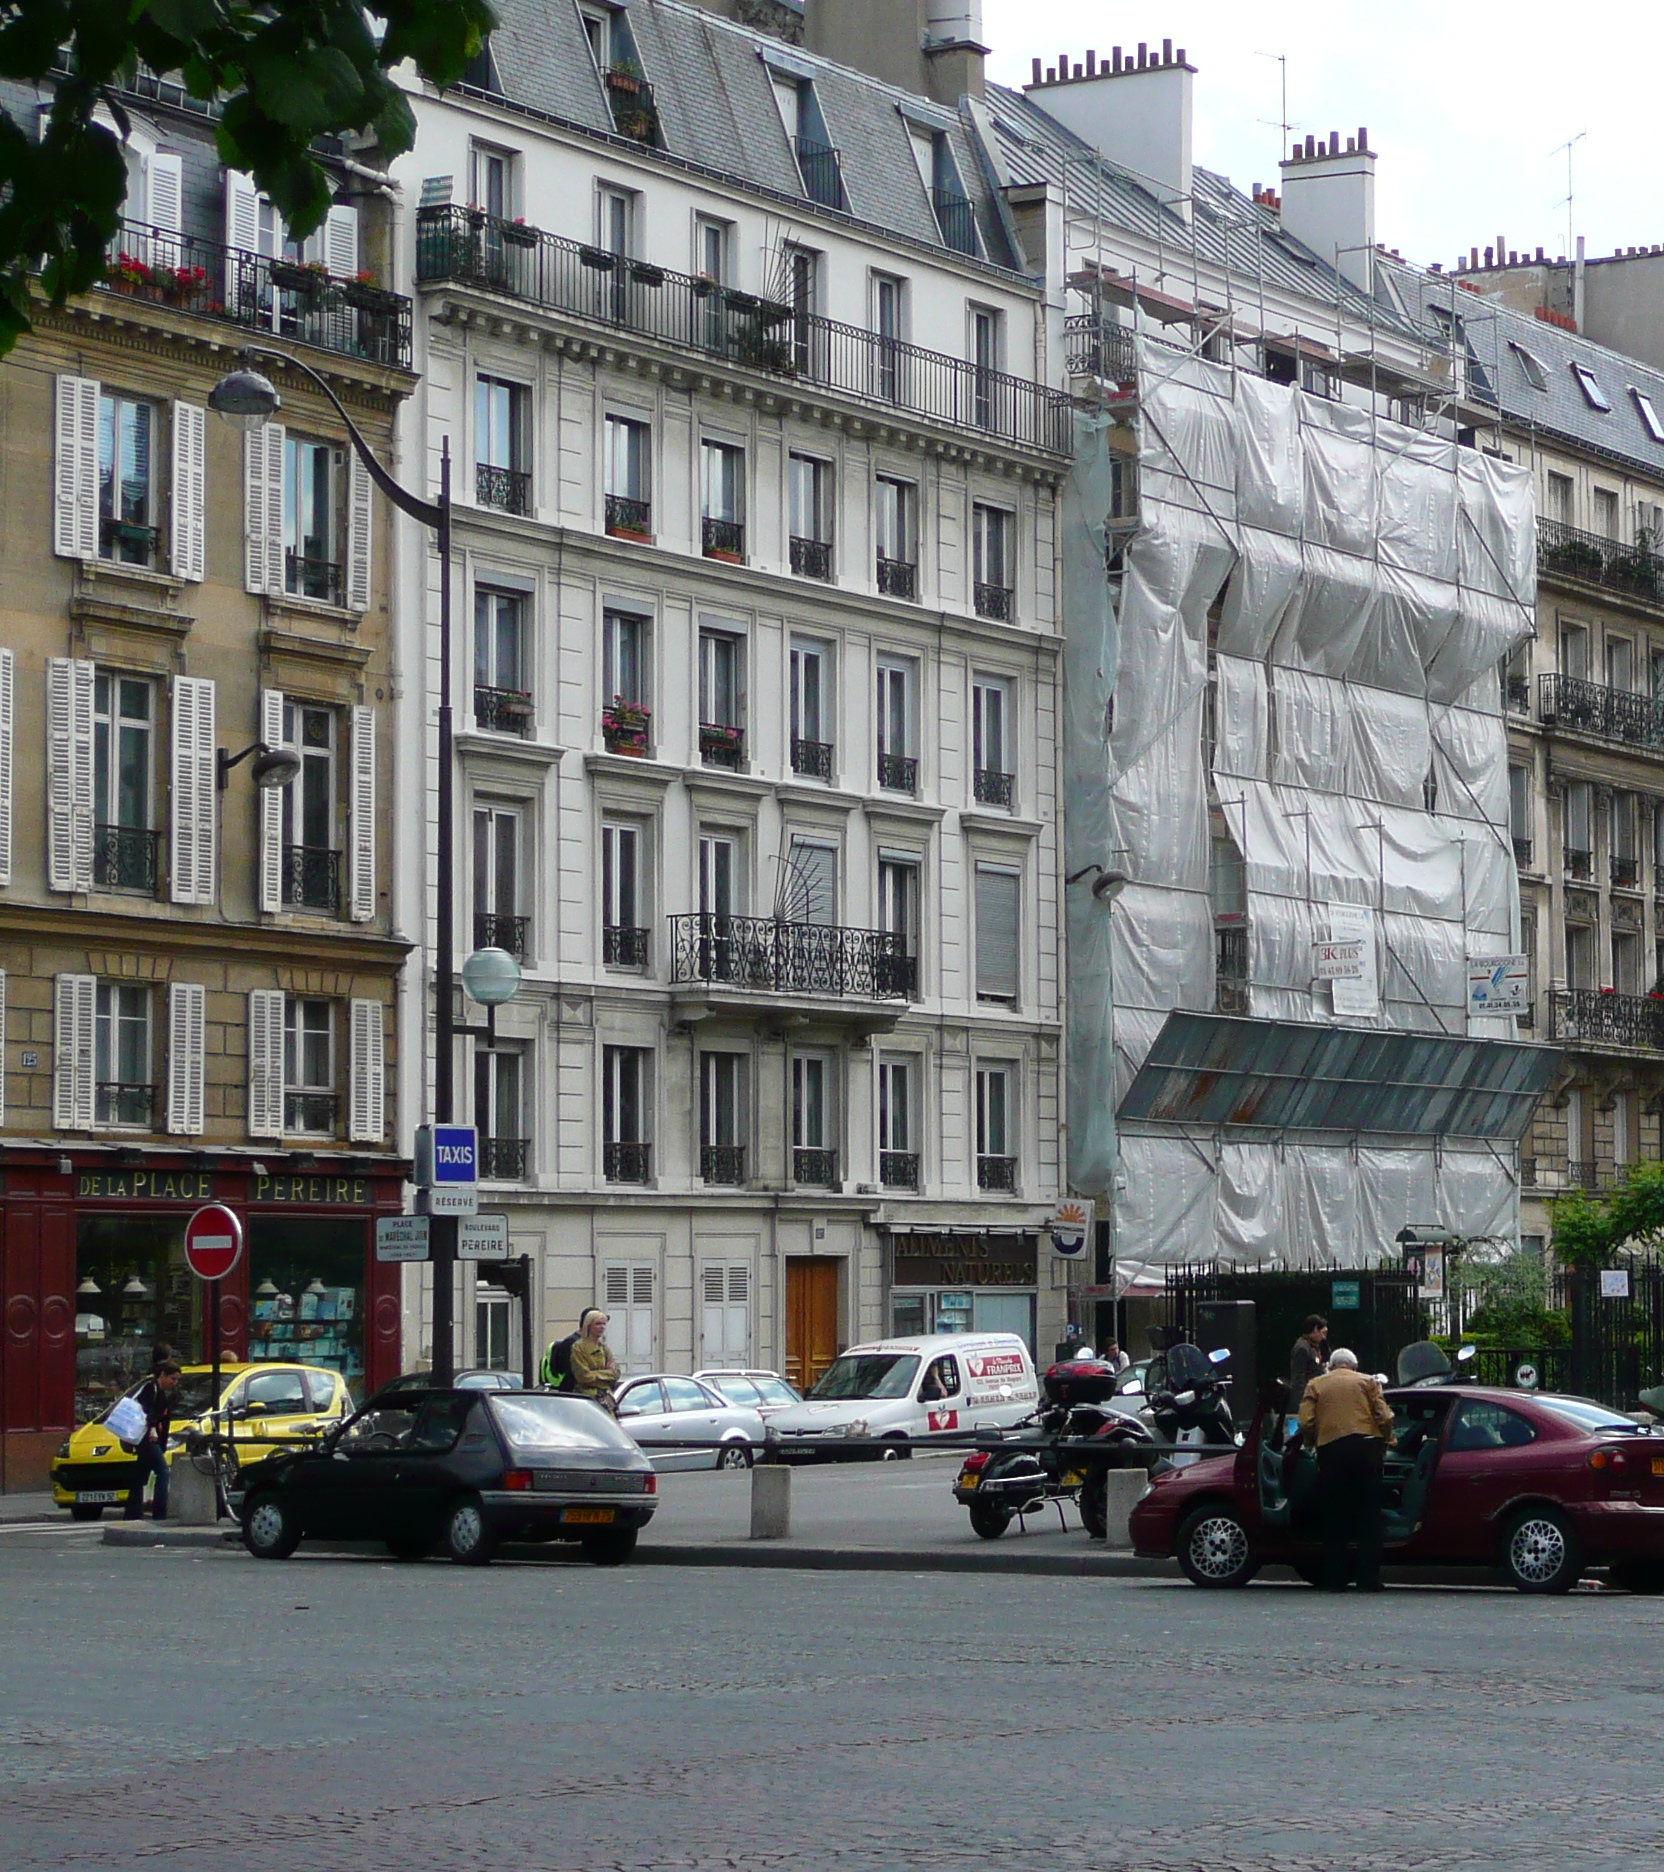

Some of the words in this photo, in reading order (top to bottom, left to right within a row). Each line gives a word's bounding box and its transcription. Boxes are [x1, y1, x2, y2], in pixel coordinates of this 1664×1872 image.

[436, 1146, 473, 1163] TAXIS
[80, 1176, 101, 1196] DE
[107, 1177, 127, 1196] LA
[132, 1172, 211, 1198] PLACE
[256, 1175, 365, 1202] PEREIRE
[392, 1220, 412, 1228] PLACE
[465, 1224, 500, 1232] BOULEVARD
[940, 1262, 1034, 1285] NATURELS
[987, 1364, 1021, 1375] FRANPRIX
